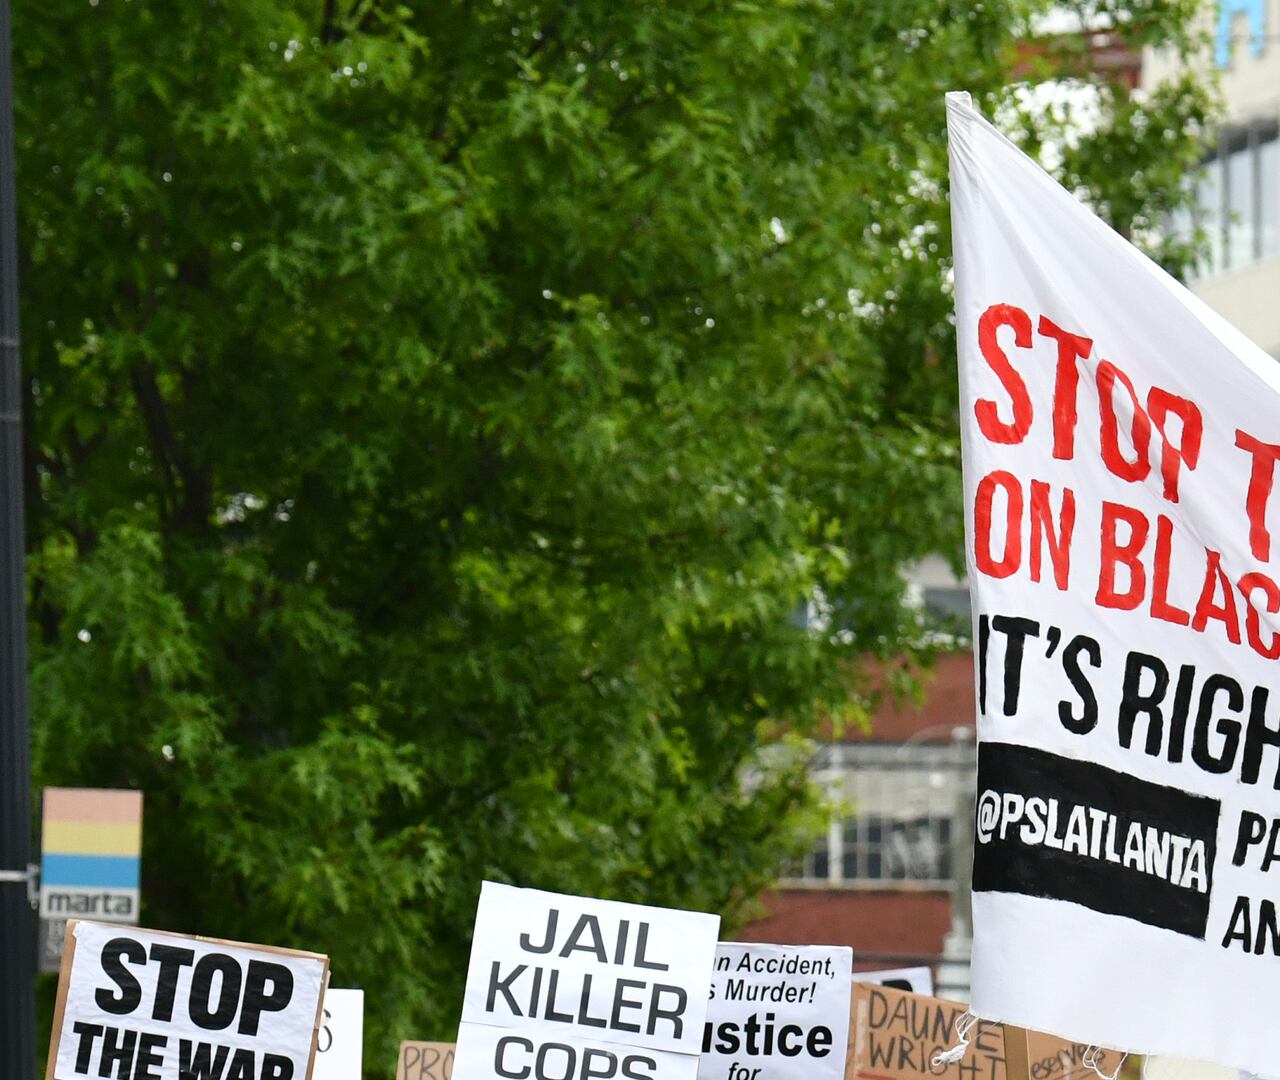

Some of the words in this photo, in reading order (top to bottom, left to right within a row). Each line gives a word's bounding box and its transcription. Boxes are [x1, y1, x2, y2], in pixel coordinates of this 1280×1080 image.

[974, 302, 1203, 503] STOP
[974, 470, 1075, 590] ON
[979, 614, 1102, 735] IT'S
[977, 789, 1208, 893] @PSLATLANTA
[48, 893, 132, 914] marta
[519, 908, 669, 971] JAIL
[94, 937, 294, 1036] STOP
[485, 961, 688, 1040] KILLER
[725, 978, 817, 1004] Murder!
[736, 951, 837, 979] Accident,
